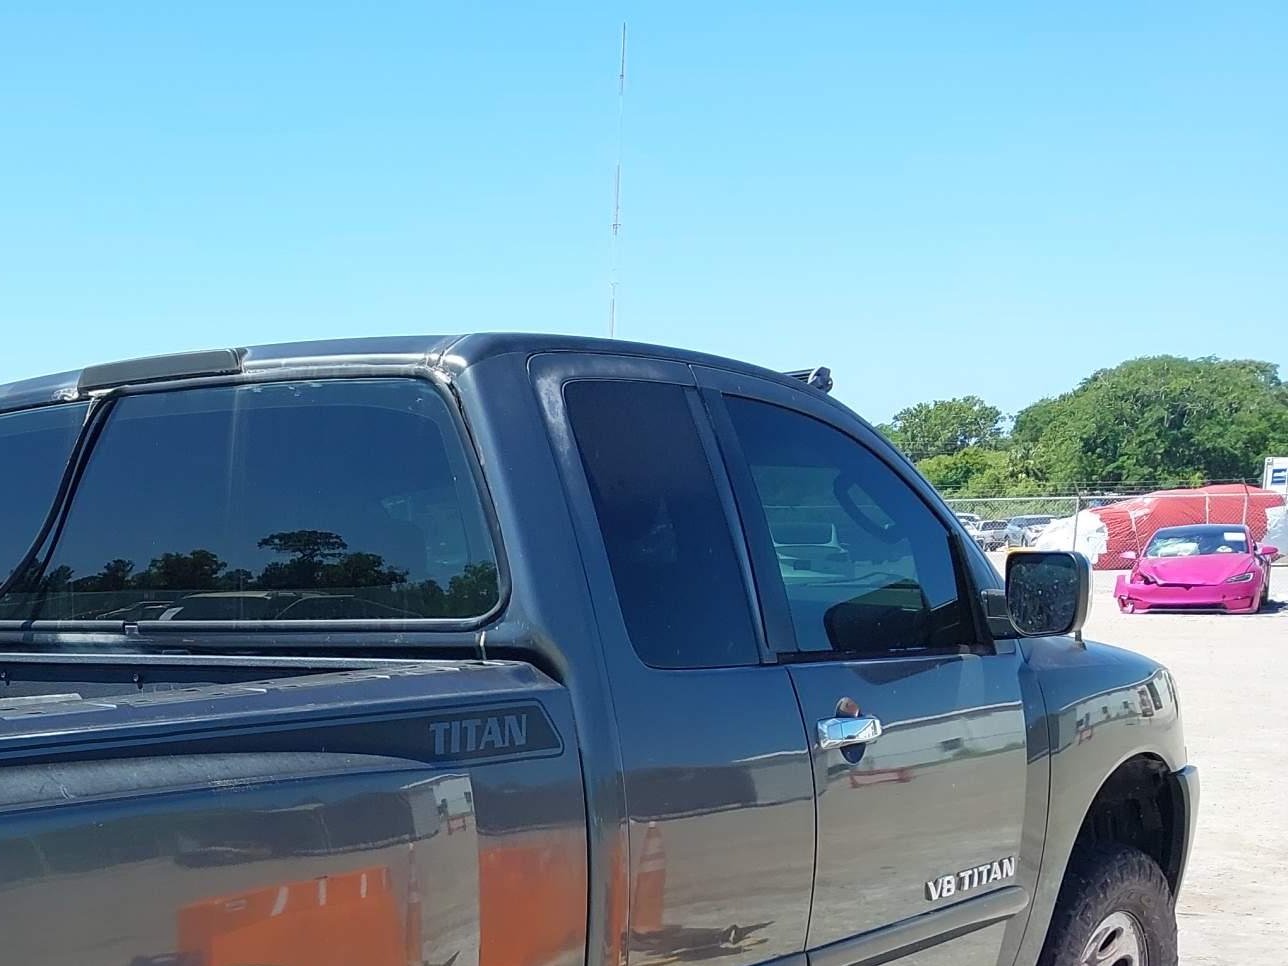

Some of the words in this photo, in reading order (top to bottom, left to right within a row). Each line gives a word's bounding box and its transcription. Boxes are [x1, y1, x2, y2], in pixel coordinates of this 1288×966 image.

[429, 713, 527, 755] TITAN
[925, 875, 956, 901] V8
[957, 856, 1016, 891] TITAN
